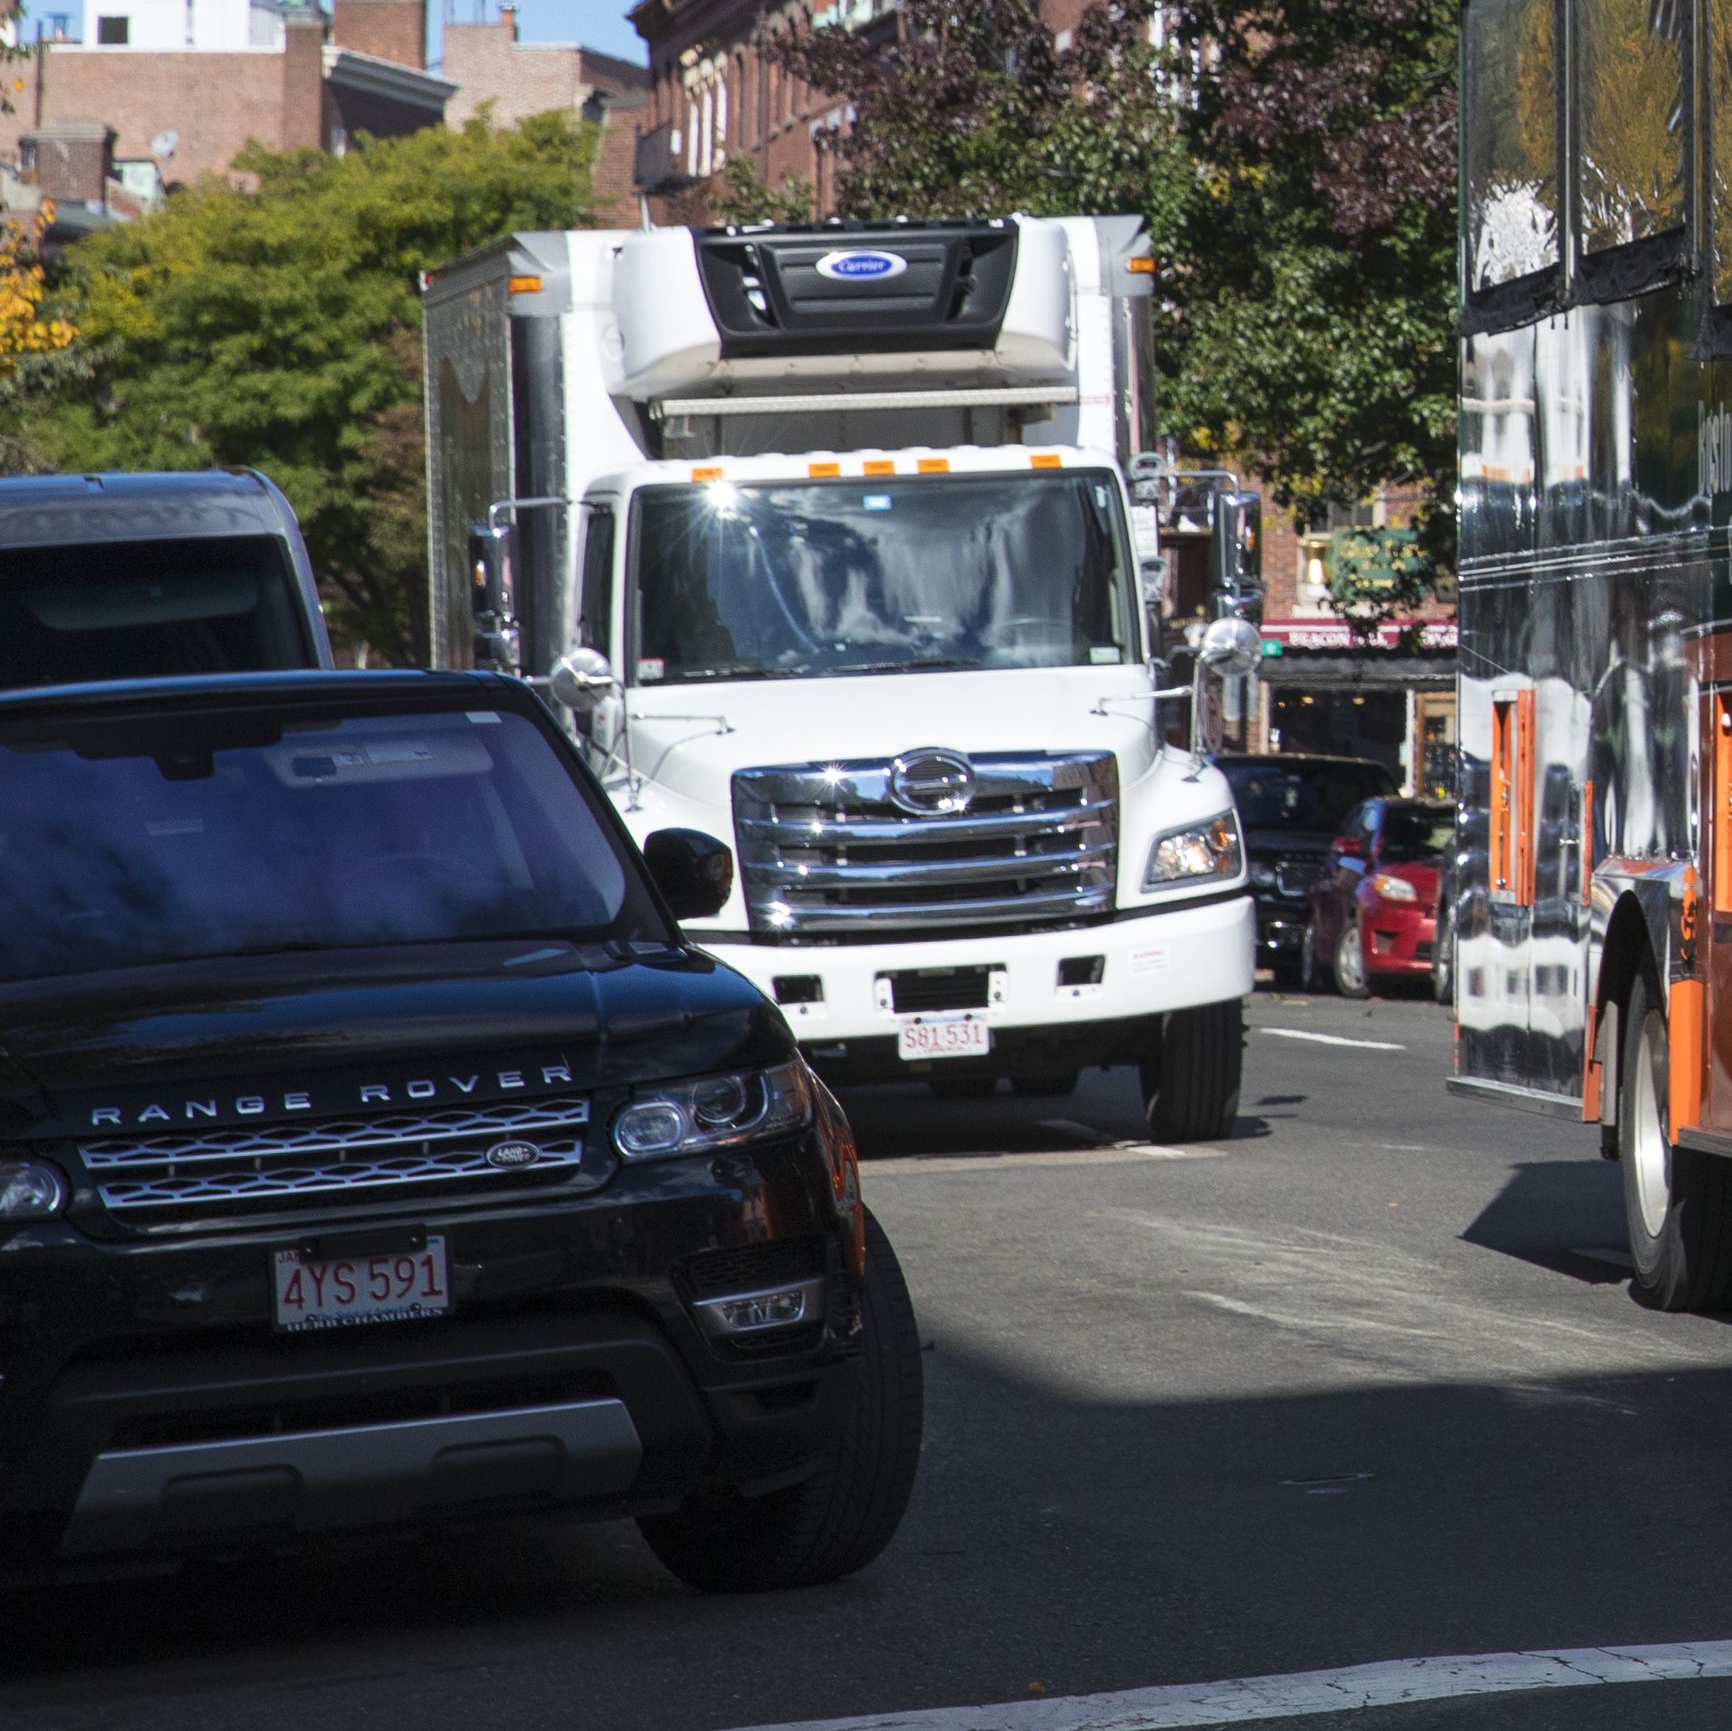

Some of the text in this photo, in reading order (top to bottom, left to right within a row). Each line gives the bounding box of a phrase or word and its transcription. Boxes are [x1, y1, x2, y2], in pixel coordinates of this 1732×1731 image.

[904, 1023, 984, 1050] S81 531
[91, 1063, 574, 1126] RANGE ROVER
[283, 1254, 443, 1310] 4YS 591
[287, 1318, 338, 1332] HERB
[342, 1308, 444, 1327] CHAMBERS
